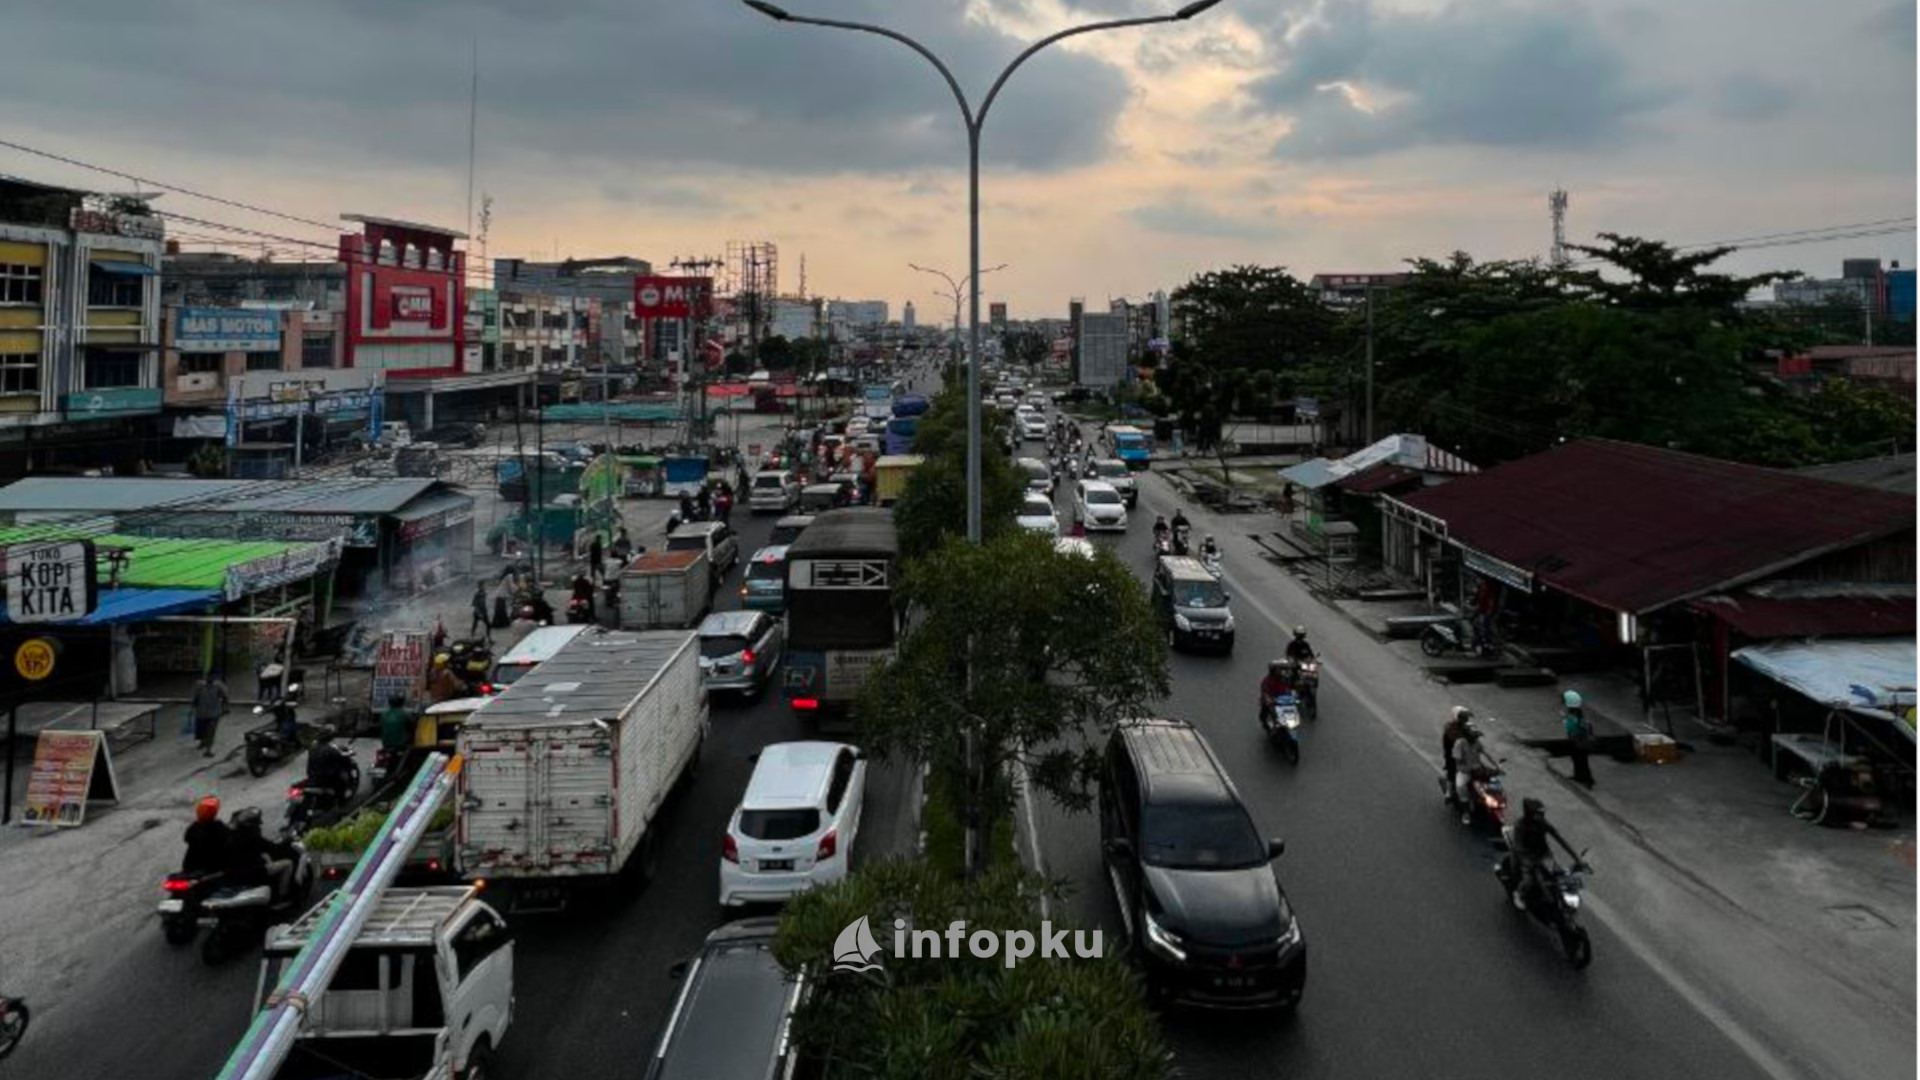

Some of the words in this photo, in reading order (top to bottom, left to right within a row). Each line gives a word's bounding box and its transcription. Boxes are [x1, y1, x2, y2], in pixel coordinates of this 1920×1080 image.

[182, 317, 217, 333] MAS
[221, 317, 272, 333] MOTOR
[31, 548, 61, 561] TOKO
[22, 562, 72, 587] KOPI
[22, 587, 74, 615] KITA
